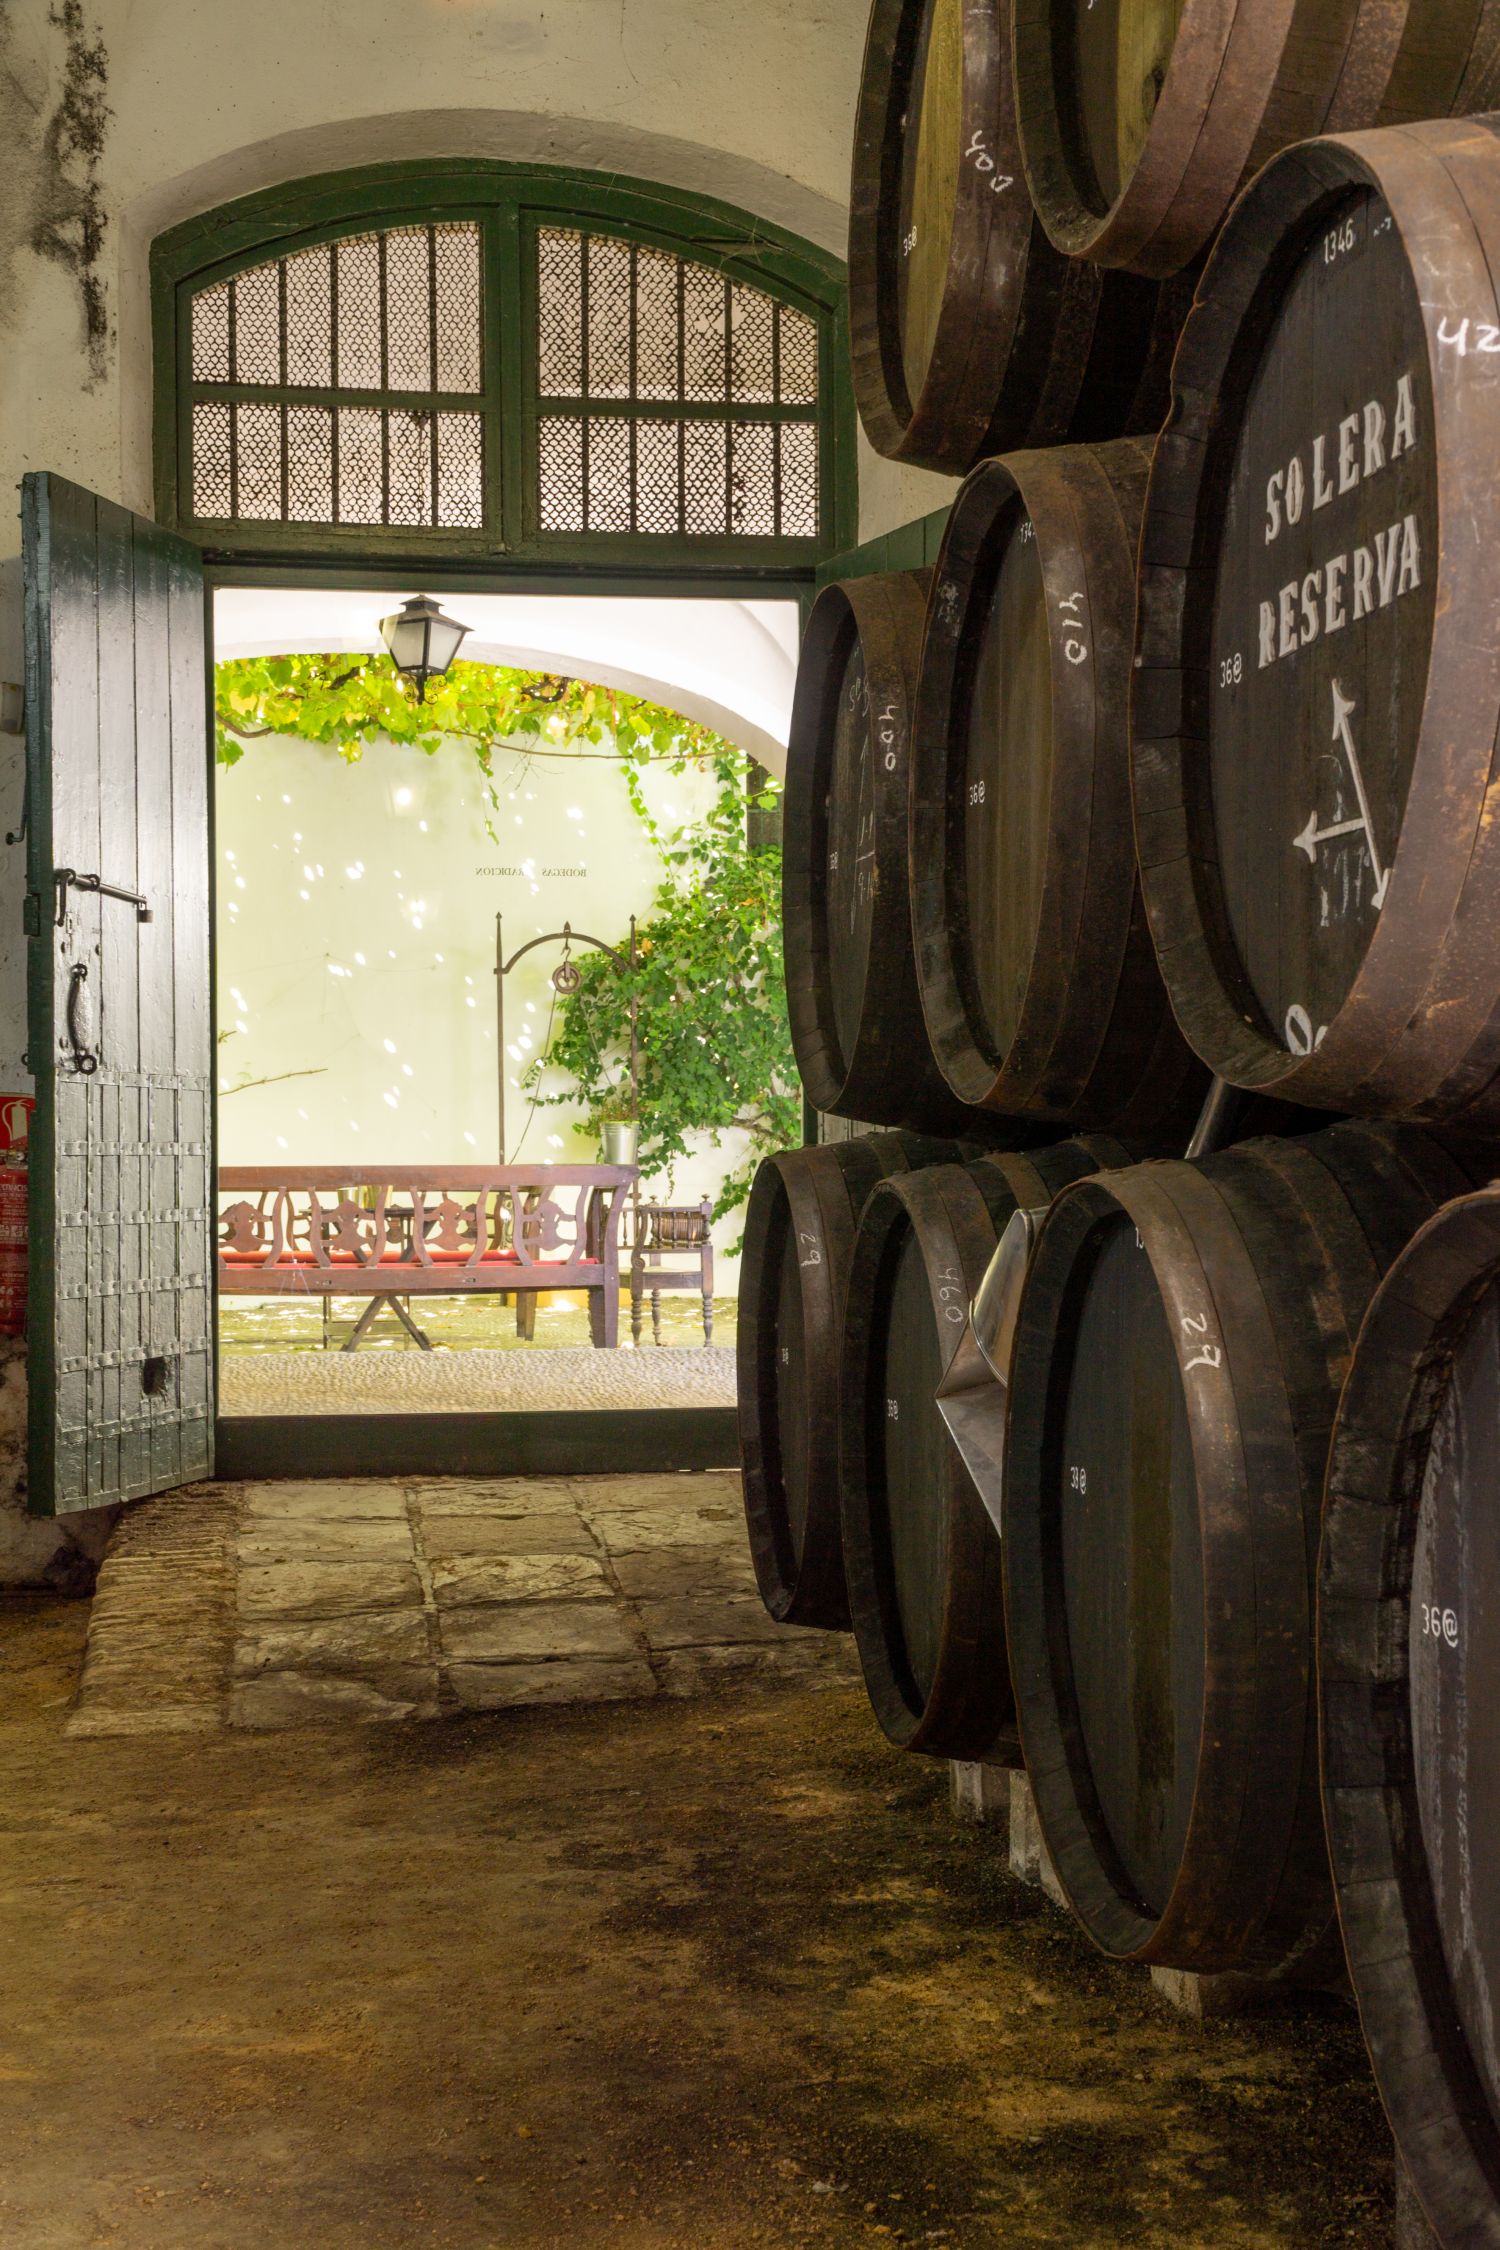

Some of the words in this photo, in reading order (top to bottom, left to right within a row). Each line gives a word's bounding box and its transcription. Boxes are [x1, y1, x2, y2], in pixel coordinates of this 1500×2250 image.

[1323, 218, 1355, 264] 1346
[1265, 374, 1418, 546] SOLERA
[1258, 514, 1421, 669] RESERVA
[1058, 591, 1088, 665] 410
[1220, 652, 1242, 688] 36@
[969, 780, 986, 806] 36@
[938, 1267, 964, 1323] 460
[1421, 1603, 1459, 1649] 36@
